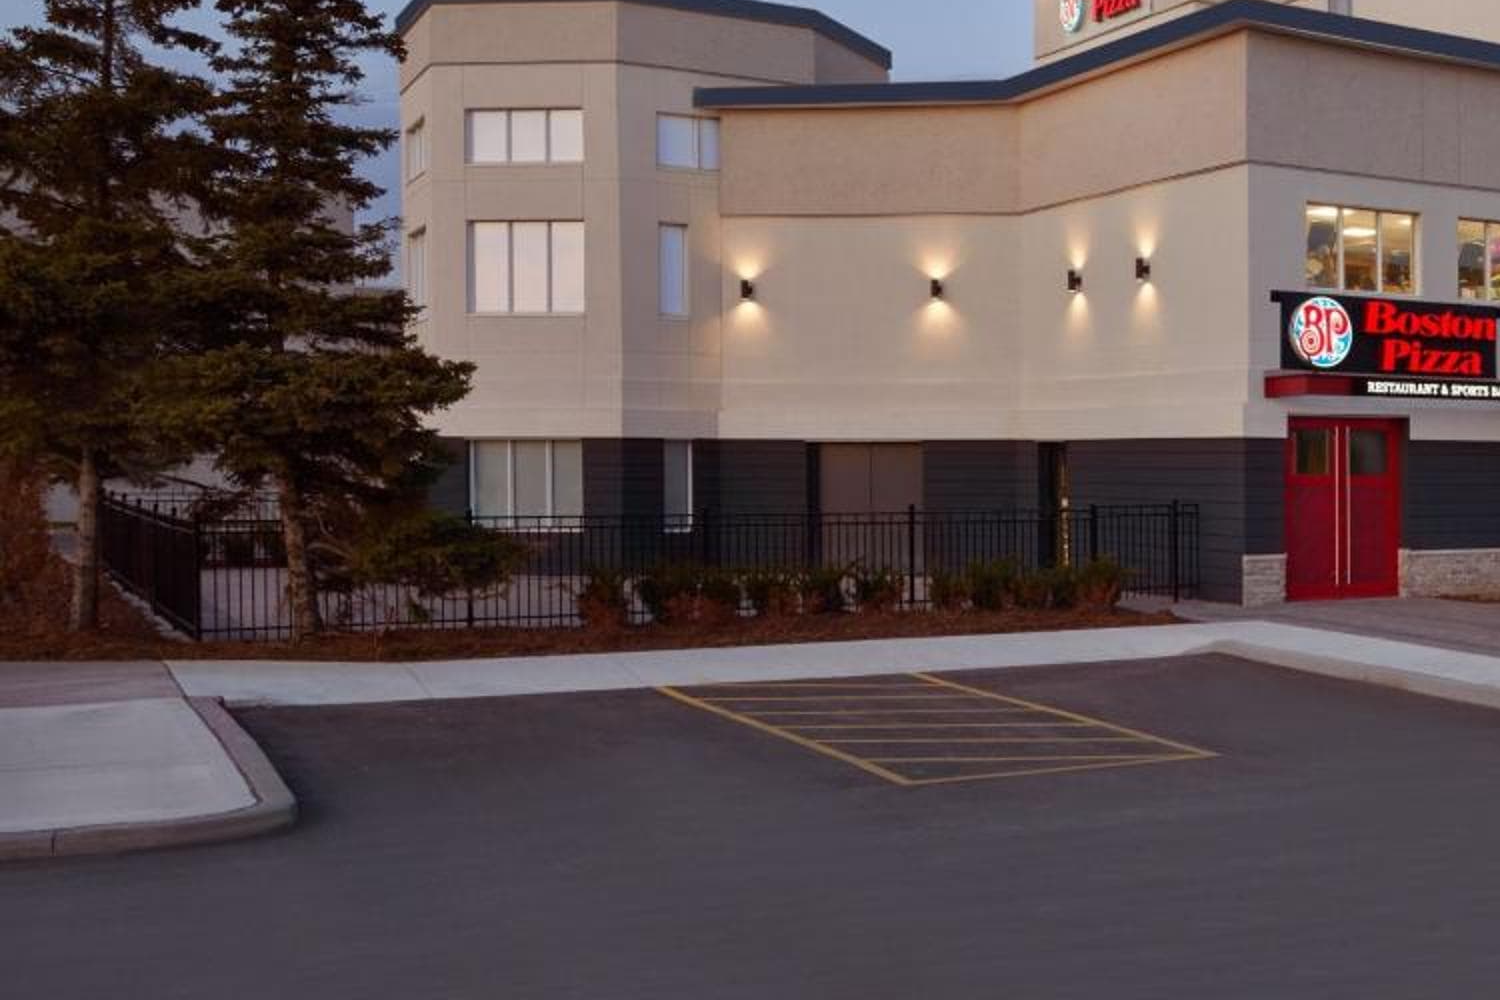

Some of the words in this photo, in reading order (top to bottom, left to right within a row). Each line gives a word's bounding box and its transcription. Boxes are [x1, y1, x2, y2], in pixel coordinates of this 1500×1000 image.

[1300, 305, 1348, 357] BP
[1363, 300, 1496, 341] Boston
[1382, 338, 1482, 374] Pizza
[1367, 381, 1439, 395] RESTAURANT
[1441, 383, 1449, 395] &
[1451, 384, 1489, 397] SPORTS
